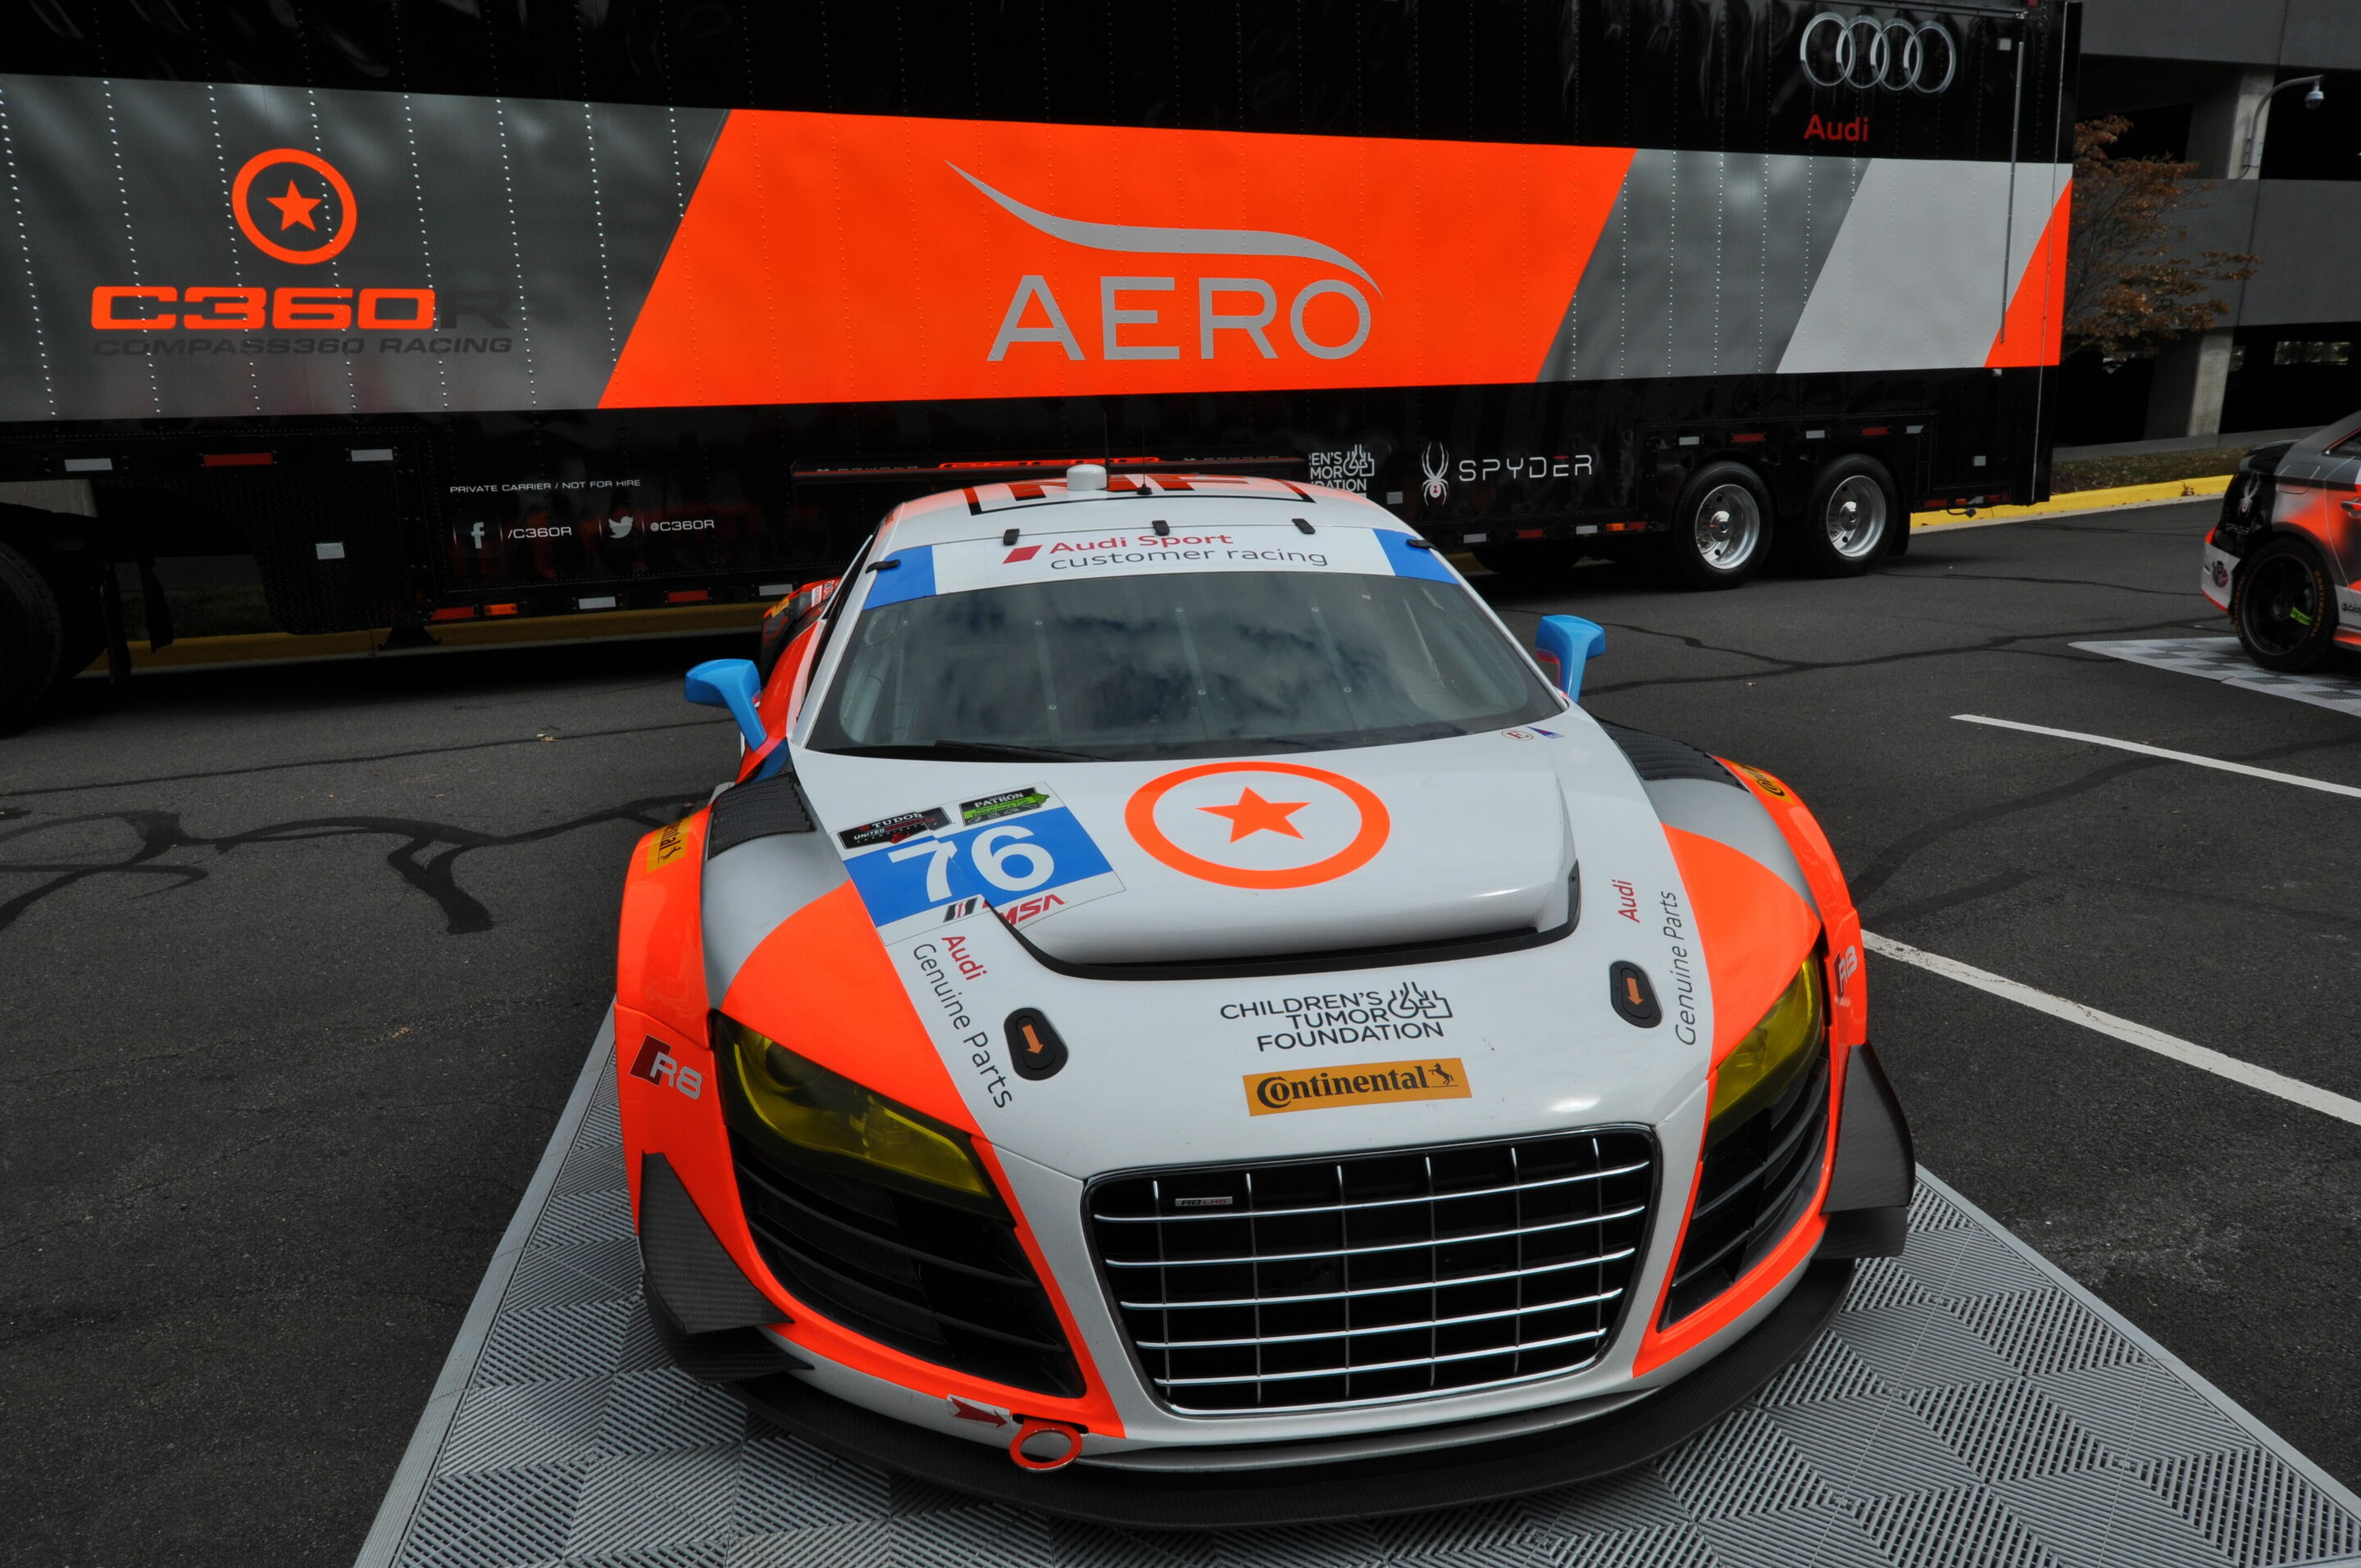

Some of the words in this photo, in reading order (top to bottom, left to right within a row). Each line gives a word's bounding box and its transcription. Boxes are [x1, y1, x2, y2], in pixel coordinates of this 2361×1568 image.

[1804, 114, 1869, 142] Audi
[986, 275, 1372, 361] AERO
[93, 337, 366, 356] COMPASS360
[378, 337, 512, 355] RACING
[1310, 466, 1343, 479] MOR
[1458, 454, 1592, 482] SPYDER
[449, 484, 498, 493] PRIVATE
[502, 482, 552, 492] CARRIER
[562, 481, 587, 489] NOT
[589, 480, 612, 489] FOR
[616, 479, 641, 488] HIRE
[650, 519, 715, 532] @C360R
[1049, 537, 1128, 554] Audi
[1138, 534, 1234, 549] Sport
[1050, 550, 1215, 570] customer
[1226, 548, 1328, 566] racing
[853, 827, 886, 840] UNITED
[871, 812, 925, 828] TUDOR
[887, 825, 1055, 903] 76
[981, 894, 1066, 926] MSA
[1612, 879, 1640, 923] Audi
[1661, 891, 1685, 940] Parts
[941, 935, 988, 980] Audi
[1220, 991, 1383, 1020] CHILDREN'S
[1667, 945, 1696, 1046] Genuine
[913, 943, 971, 1030] Genuine
[962, 1030, 1013, 1109] Parts
[1285, 1007, 1390, 1029] TUMOR
[1257, 1021, 1444, 1052] FOUNDATION
[649, 1051, 702, 1099] R8
[1256, 1066, 1431, 1109] Continental
